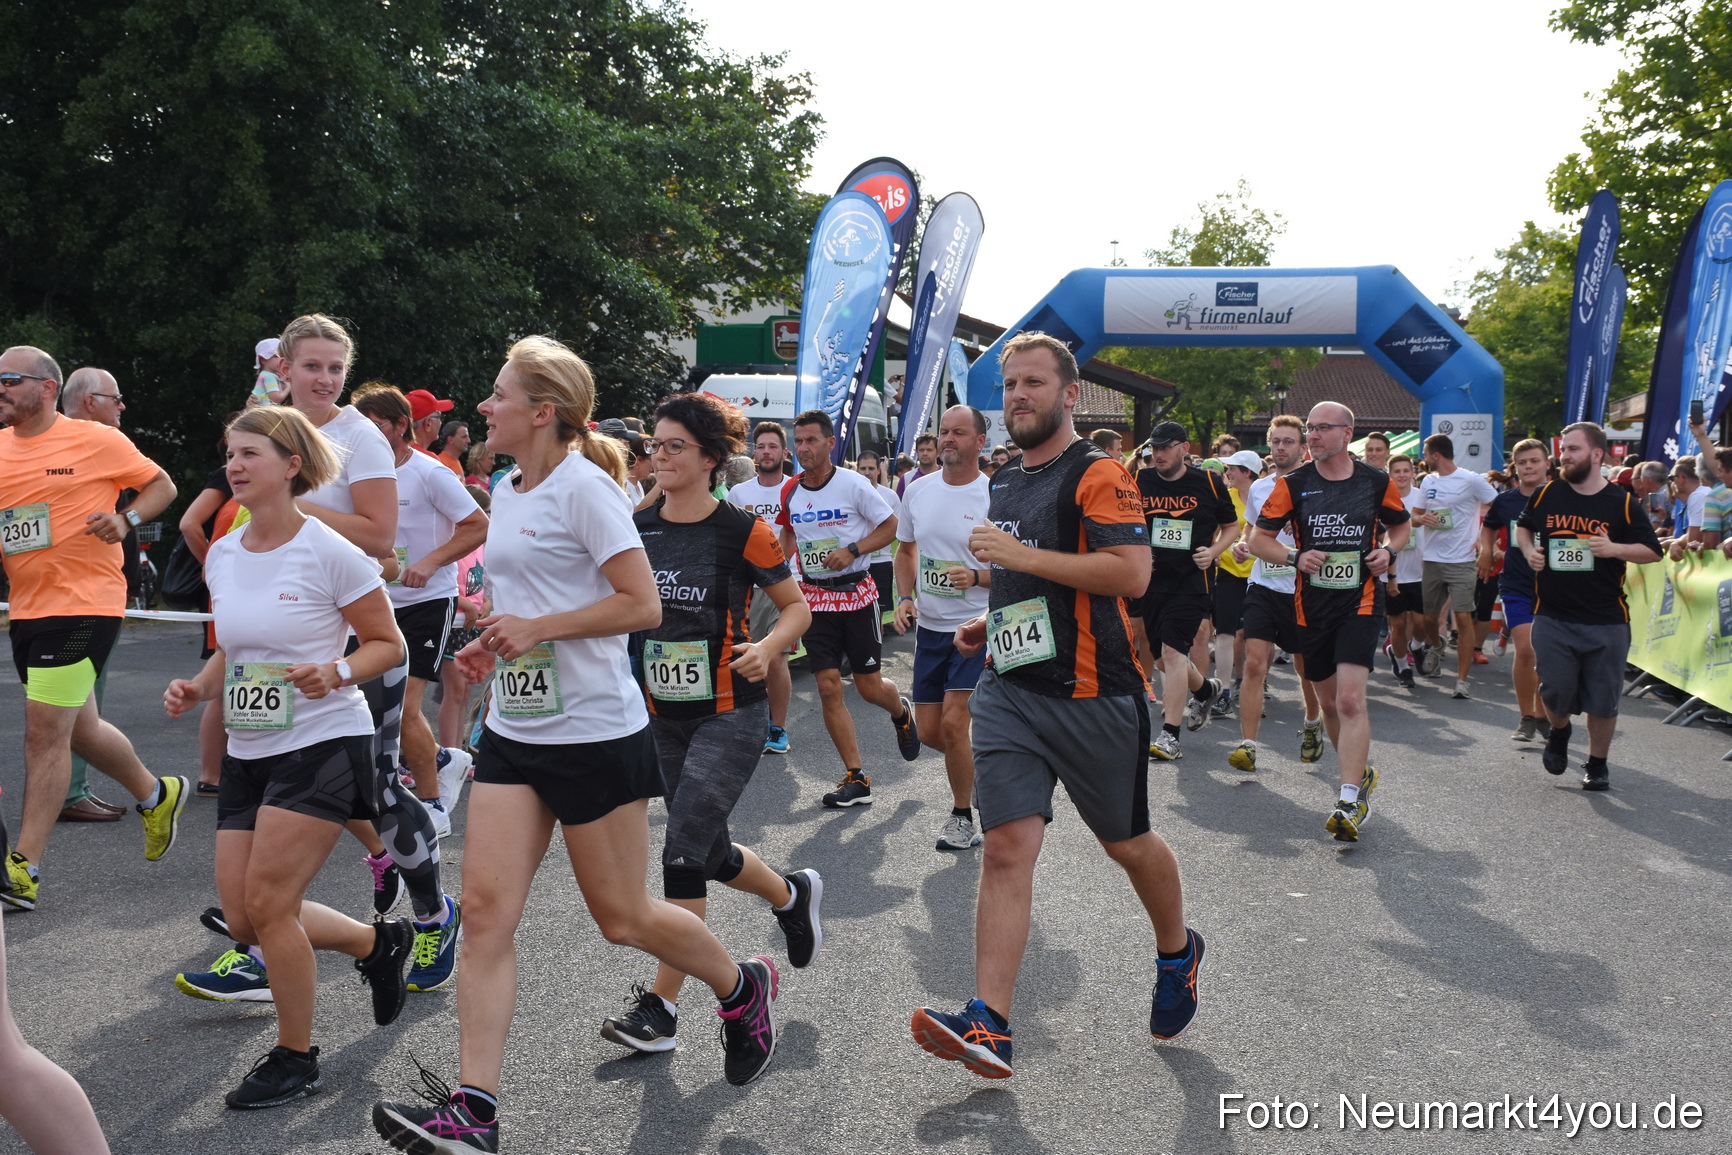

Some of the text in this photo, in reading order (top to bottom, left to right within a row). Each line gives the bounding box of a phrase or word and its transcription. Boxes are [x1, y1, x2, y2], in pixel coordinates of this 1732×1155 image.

[947, 226, 971, 296] AUTOMOBILE
[1585, 214, 1608, 306] Fischer
[1224, 290, 1256, 298] Fischer
[1200, 307, 1294, 324] firmenlauf
[46, 468, 74, 476] THULE
[1150, 495, 1198, 509] WINGS
[755, 504, 781, 515] GRA
[1308, 513, 1348, 526] HECK
[1546, 514, 1610, 535] BIT WINGS
[3, 519, 40, 543] 2301
[1160, 529, 1182, 541] 283
[1312, 525, 1366, 538] DESIGN
[804, 550, 834, 566] 206
[1557, 550, 1584, 562] 286
[651, 570, 682, 585] CK
[1319, 565, 1354, 579] 1020
[279, 593, 298, 601] Silvia
[656, 585, 708, 602] SIGN
[821, 592, 849, 601] AVIA
[811, 600, 838, 612] AVIA
[838, 599, 865, 612] AVIA
[993, 621, 1042, 655] 1014
[1015, 647, 1031, 655] Mario
[650, 662, 700, 685] 1015
[499, 669, 548, 697] 1024
[229, 686, 281, 711] 1026
[522, 697, 544, 705] Christa
[250, 710, 268, 718] Silvia
